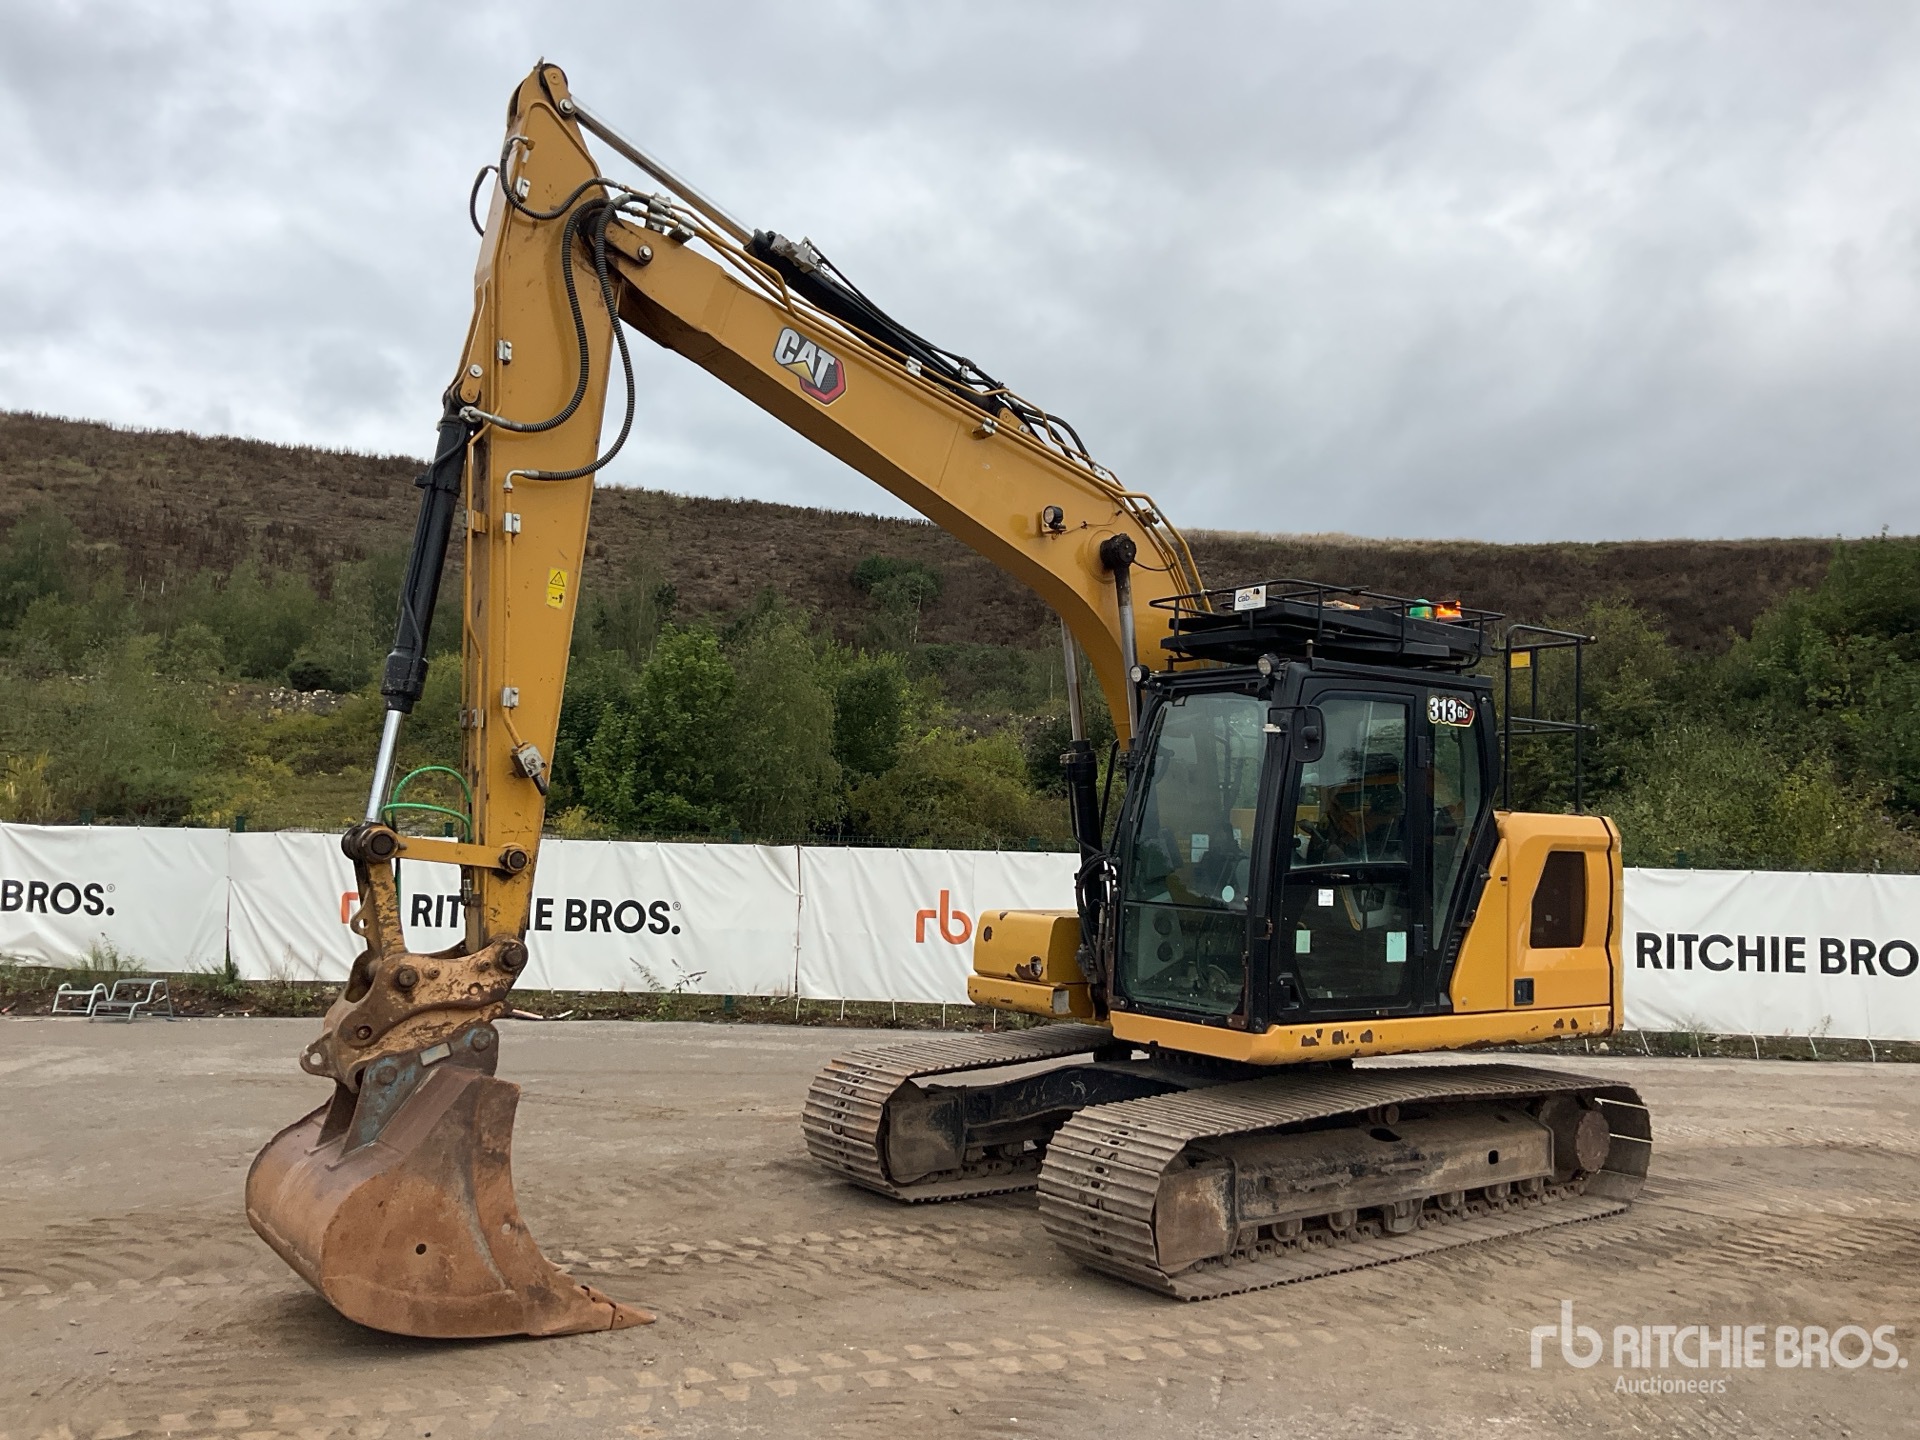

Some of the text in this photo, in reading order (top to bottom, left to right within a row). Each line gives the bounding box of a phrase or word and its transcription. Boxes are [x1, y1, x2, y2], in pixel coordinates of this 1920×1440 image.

[774, 327, 836, 388] CAT
[1429, 697, 1468, 722] 313 GC
[564, 898, 681, 935] BROS.
[915, 889, 973, 945] rb
[1636, 932, 1806, 973] RITCHIE
